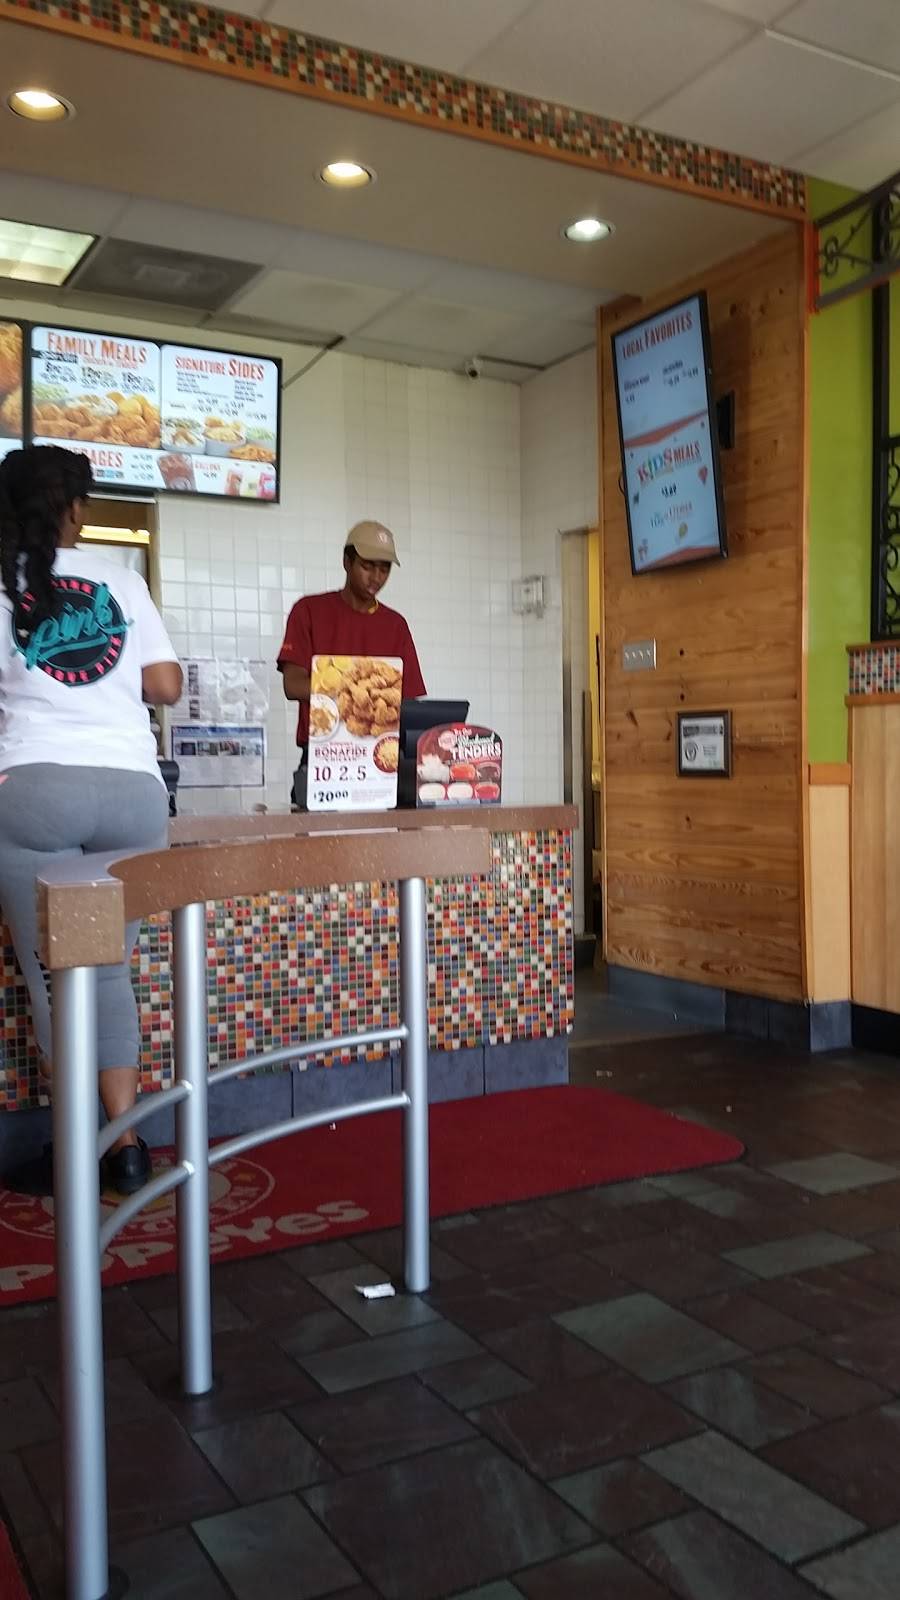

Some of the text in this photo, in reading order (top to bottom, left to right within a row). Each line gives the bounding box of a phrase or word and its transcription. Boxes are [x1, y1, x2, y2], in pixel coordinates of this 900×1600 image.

[47, 332, 97, 358] FAMILY
[100, 339, 148, 363] MEALS
[622, 311, 693, 360] LOCAL FAVORITES
[175, 355, 265, 381] SIGNATURE SIDES
[672, 439, 702, 464] MEALS
[314, 745, 369, 759] BONAFIDE
[449, 742, 502, 761] TENDERS
[313, 765, 368, 782] 10 2 5
